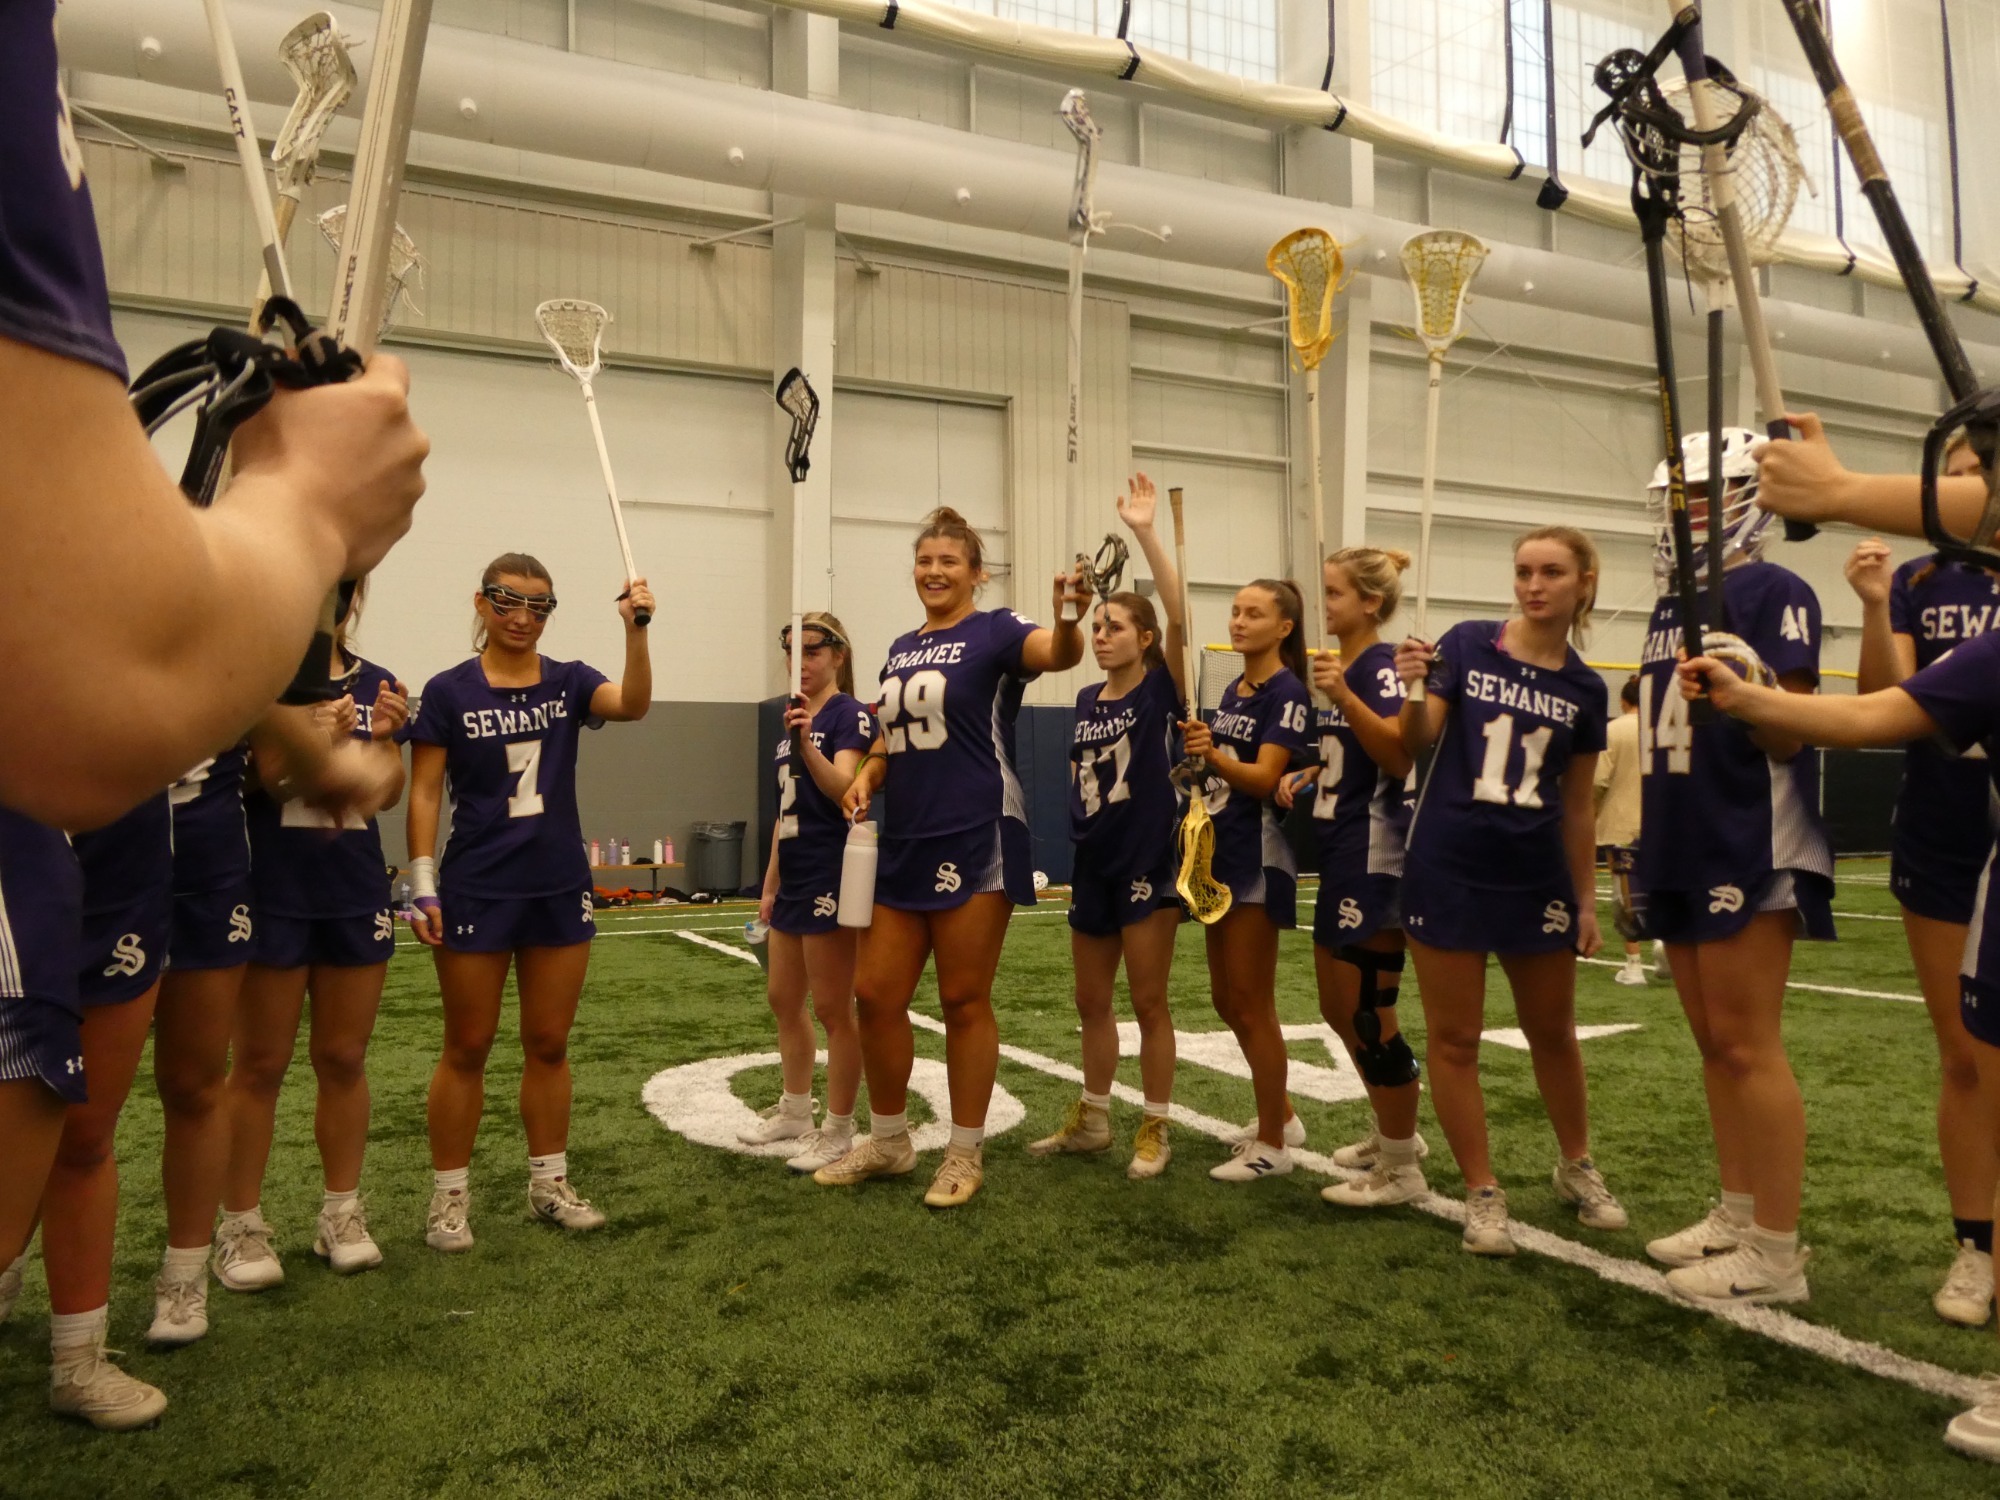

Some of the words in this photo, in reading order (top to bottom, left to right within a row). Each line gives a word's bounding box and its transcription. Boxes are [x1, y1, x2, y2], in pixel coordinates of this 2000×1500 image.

[225, 87, 245, 138] GAIT
[337, 255, 358, 323] DIAMETER
[1066, 423, 1078, 464] STX
[857, 711, 871, 738] 2
[878, 669, 948, 755] 29
[1212, 710, 1256, 742] WANEE
[1279, 700, 1307, 732] 16
[1465, 670, 1579, 729] SEWANEE
[505, 739, 544, 818] 7
[1473, 713, 1553, 809] 11
